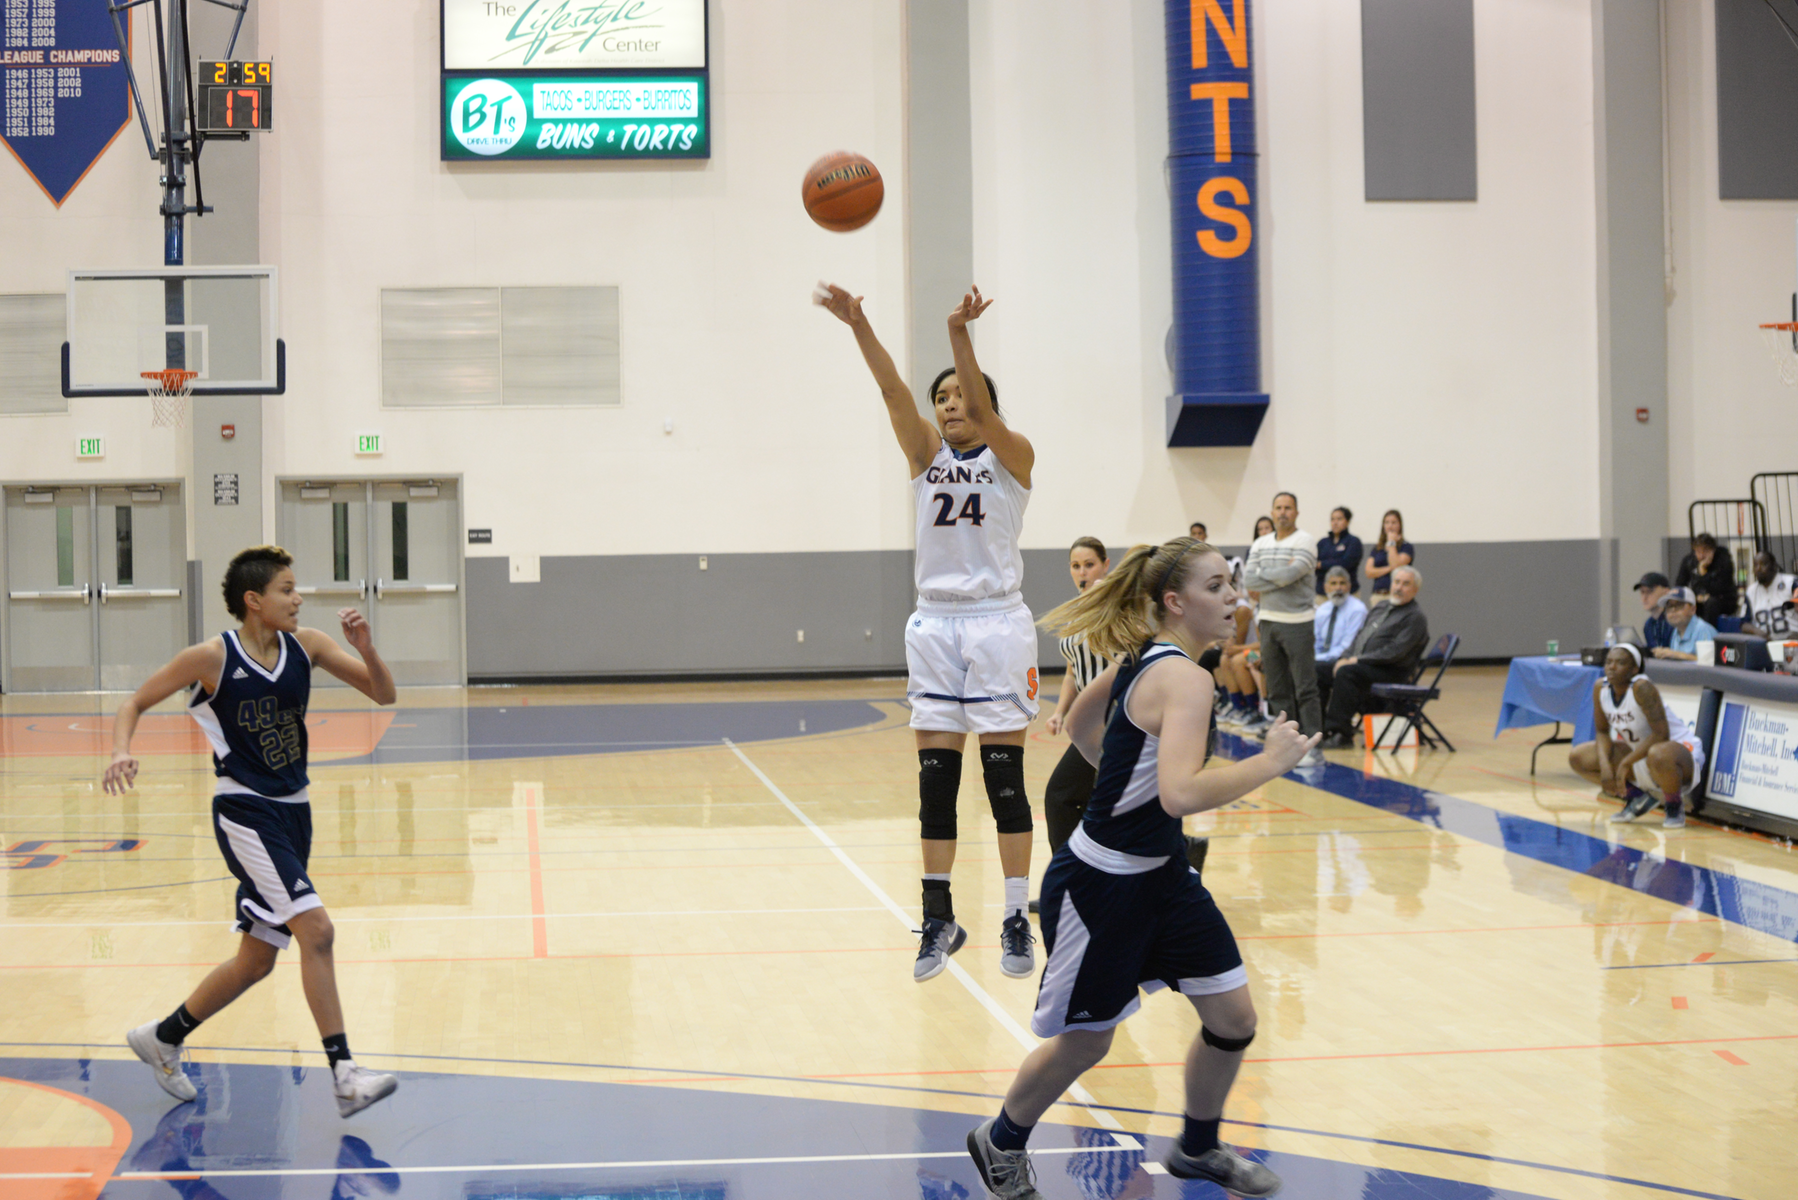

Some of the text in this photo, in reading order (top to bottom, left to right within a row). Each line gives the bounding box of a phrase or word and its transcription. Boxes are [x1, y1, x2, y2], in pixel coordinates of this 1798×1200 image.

[5, 8, 56, 18] 1957 1999
[482, 1, 517, 17] The
[5, 18, 56, 27] 1973 2000
[5, 28, 56, 37] 1982 2004
[505, 0, 664, 66] Lifestyle
[31, 37, 56, 47] 2008
[602, 37, 662, 53] Center
[0, 49, 120, 63] LEAGUE CHAMPIONS
[5, 67, 81, 79] 1946 1953 2001
[214, 62, 271, 84] 2:59
[5, 77, 81, 88] 1947 1958 2002
[5, 87, 81, 98] 1948 1969 2010
[6, 98, 54, 108] 1949 1973
[540, 89, 692, 112] TACOS BURGERS BURRITOS
[6, 107, 55, 117] 1950 1982
[225, 89, 259, 128] 17
[6, 116, 55, 127] 1951 1984
[6, 126, 55, 137] 1952 1990
[536, 122, 698, 151] BUNS & TORTS
[466, 137, 513, 146] DRIVE THRU
[80, 438, 101, 455] EXIT
[359, 435, 380, 452] EXIT
[933, 492, 987, 528] 24
[259, 722, 301, 771] 22
